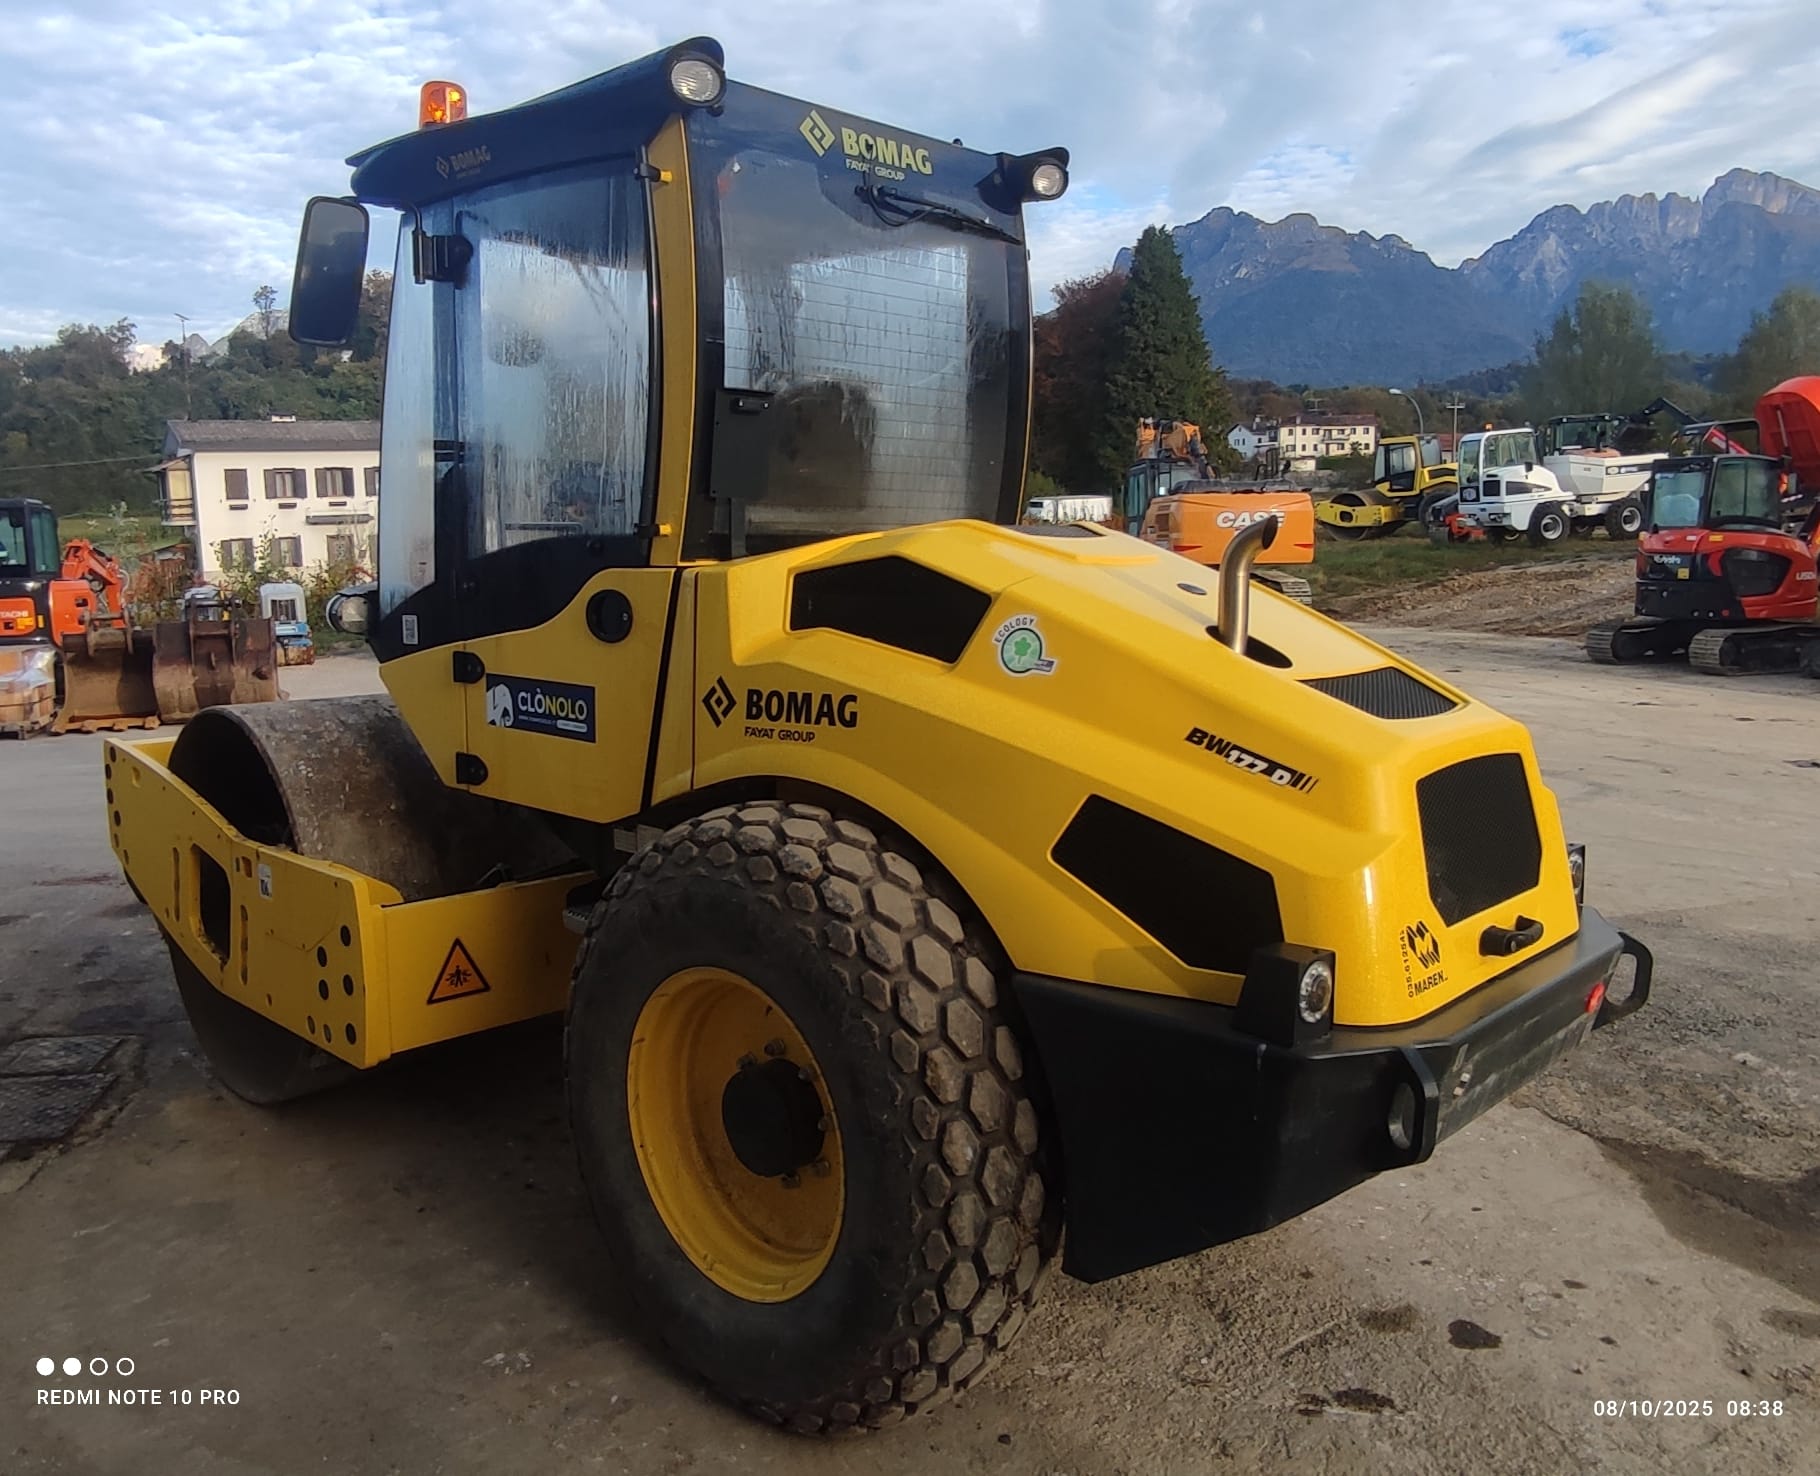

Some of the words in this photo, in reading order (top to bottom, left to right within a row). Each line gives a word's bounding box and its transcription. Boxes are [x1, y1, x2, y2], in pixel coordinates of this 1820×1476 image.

[841, 127, 932, 175] BOMAG
[846, 158, 870, 172] FAYA
[875, 166, 905, 181] GROUP
[994, 617, 1035, 643] ECOLOGY
[517, 687, 588, 720] CLÒNOLO
[745, 688, 858, 728] BOMAG
[744, 726, 775, 740] FAYAT
[778, 729, 816, 743] GROUP
[1271, 768, 1293, 787] D
